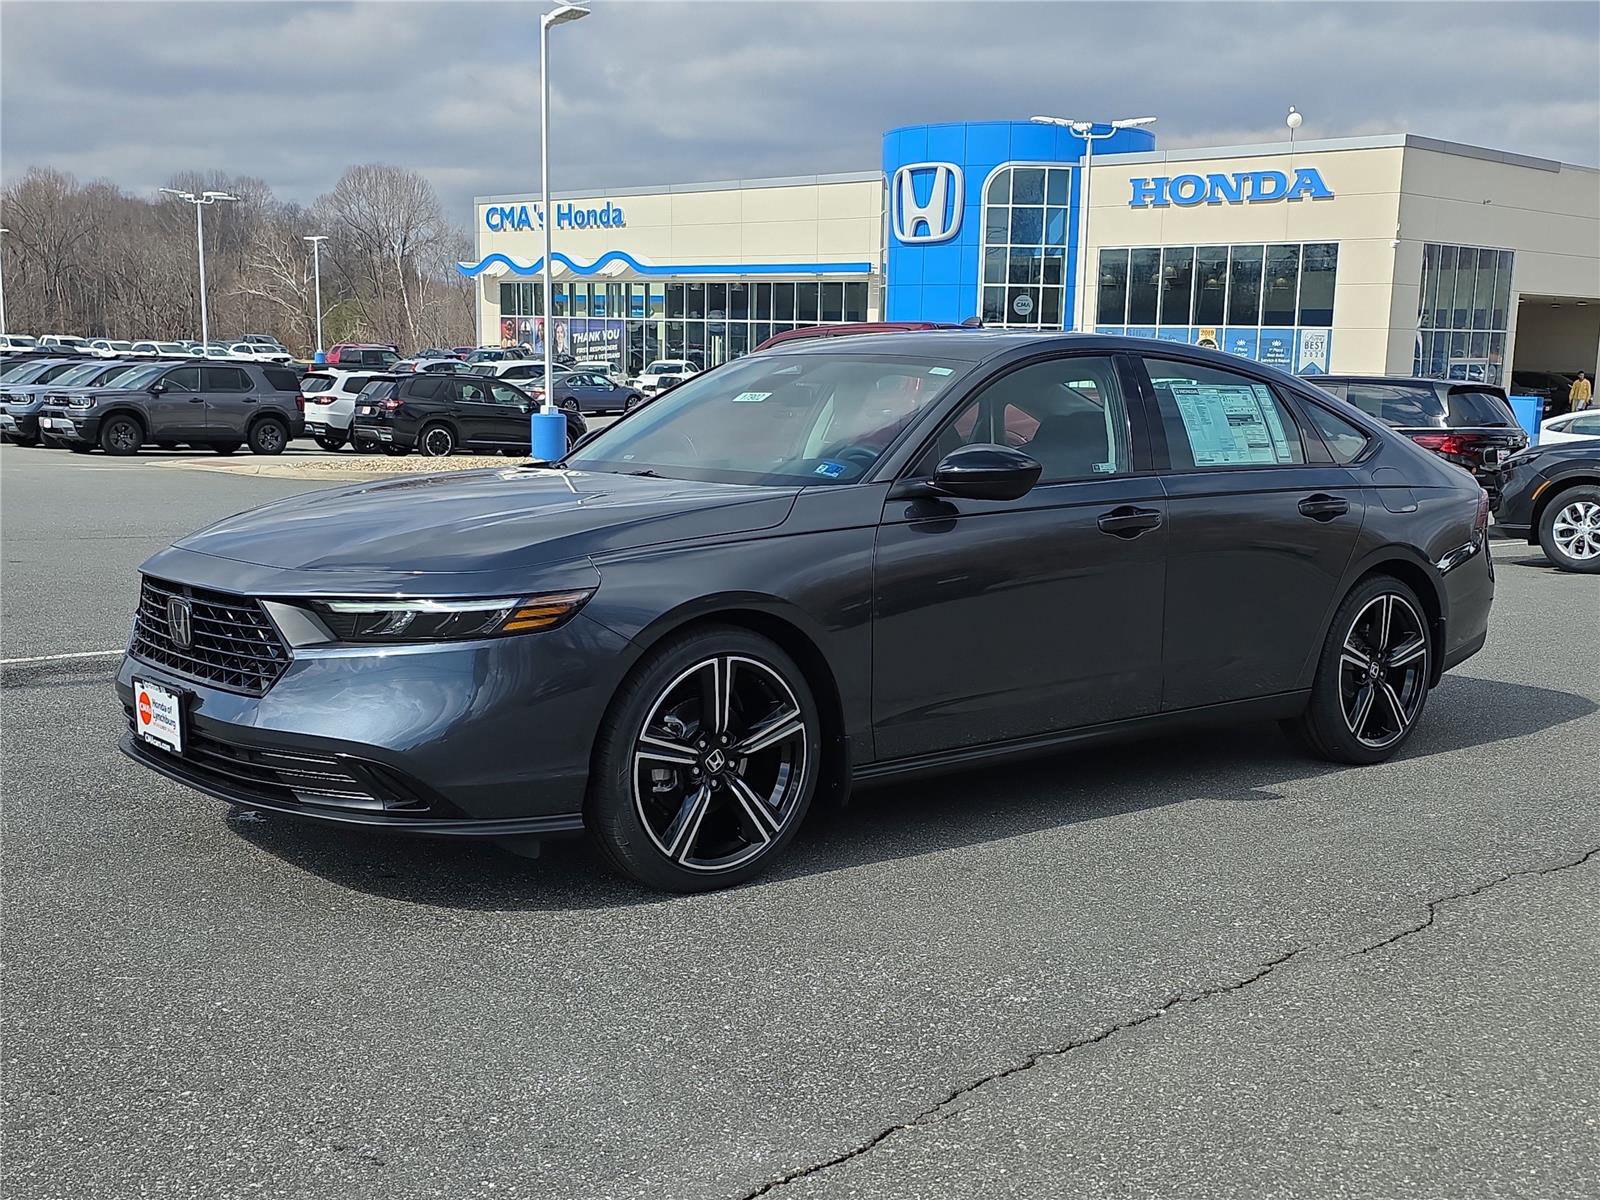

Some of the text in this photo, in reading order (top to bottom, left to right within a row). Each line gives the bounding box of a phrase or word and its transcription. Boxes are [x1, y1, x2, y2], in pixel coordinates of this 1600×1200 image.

[1128, 168, 1334, 209] HONDA
[556, 201, 625, 229] Honda
[573, 329, 619, 344] THANK YOU
[589, 344, 618, 353] RESPODERS
[1304, 341, 1324, 349] BEST
